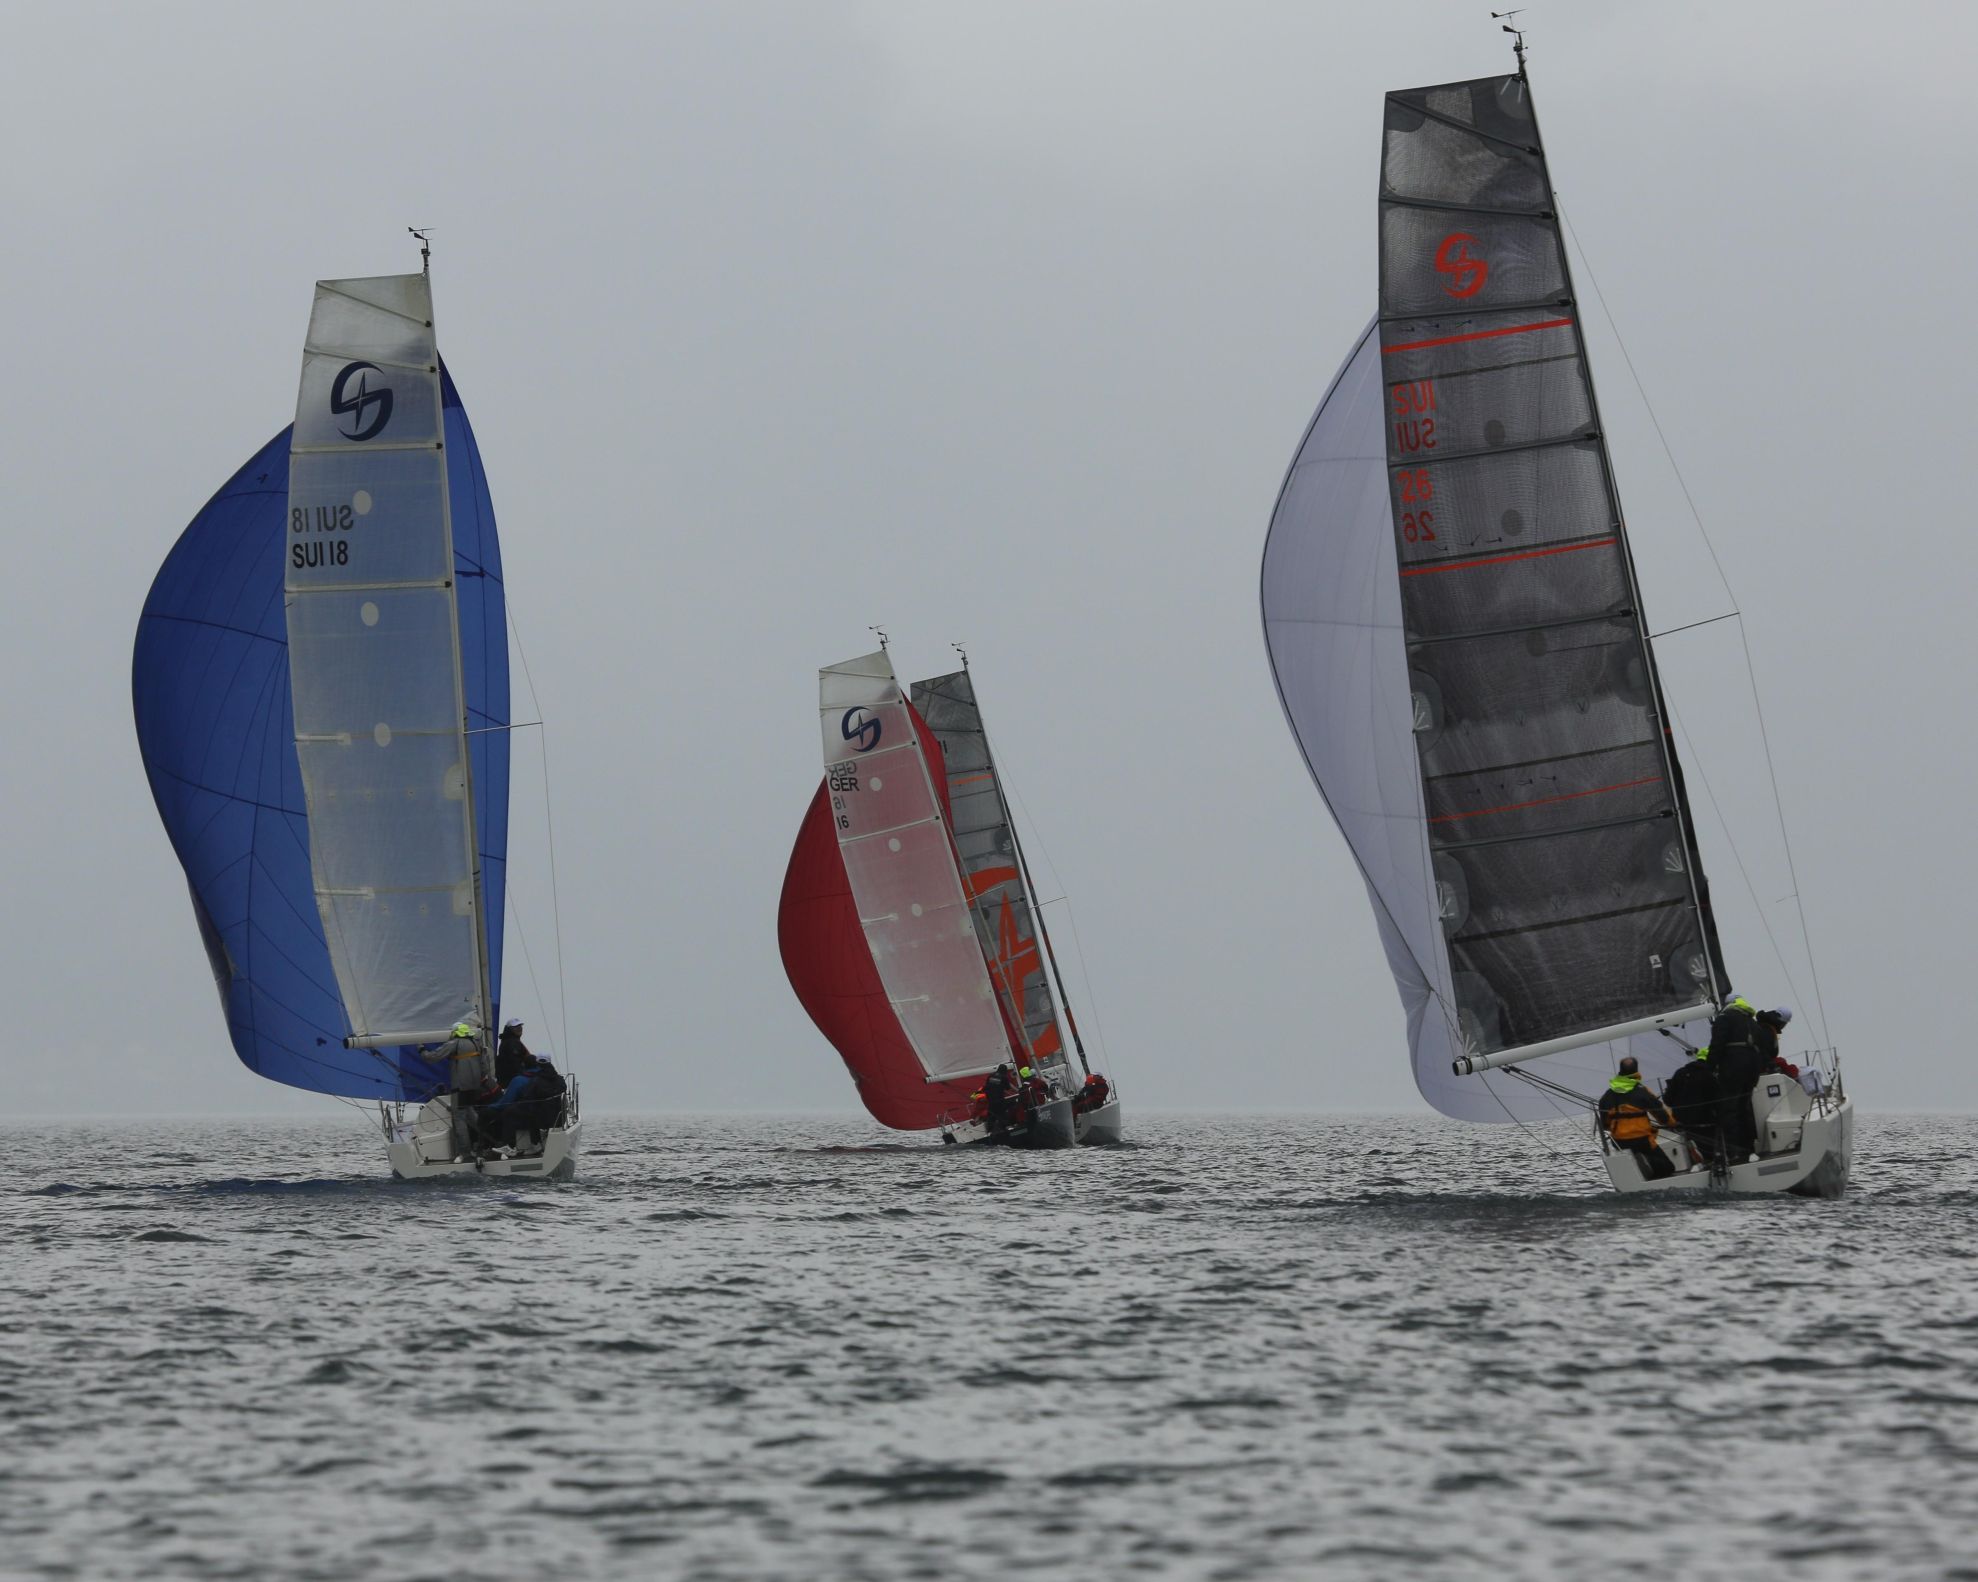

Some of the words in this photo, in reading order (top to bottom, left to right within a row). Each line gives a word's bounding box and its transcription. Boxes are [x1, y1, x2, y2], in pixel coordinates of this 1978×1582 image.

[1393, 379, 1436, 415] SUI
[1396, 468, 1434, 505] 26
[292, 541, 324, 569] SUI
[330, 541, 348, 566] 18
[829, 778, 860, 791] GER
[837, 815, 849, 830] 16
